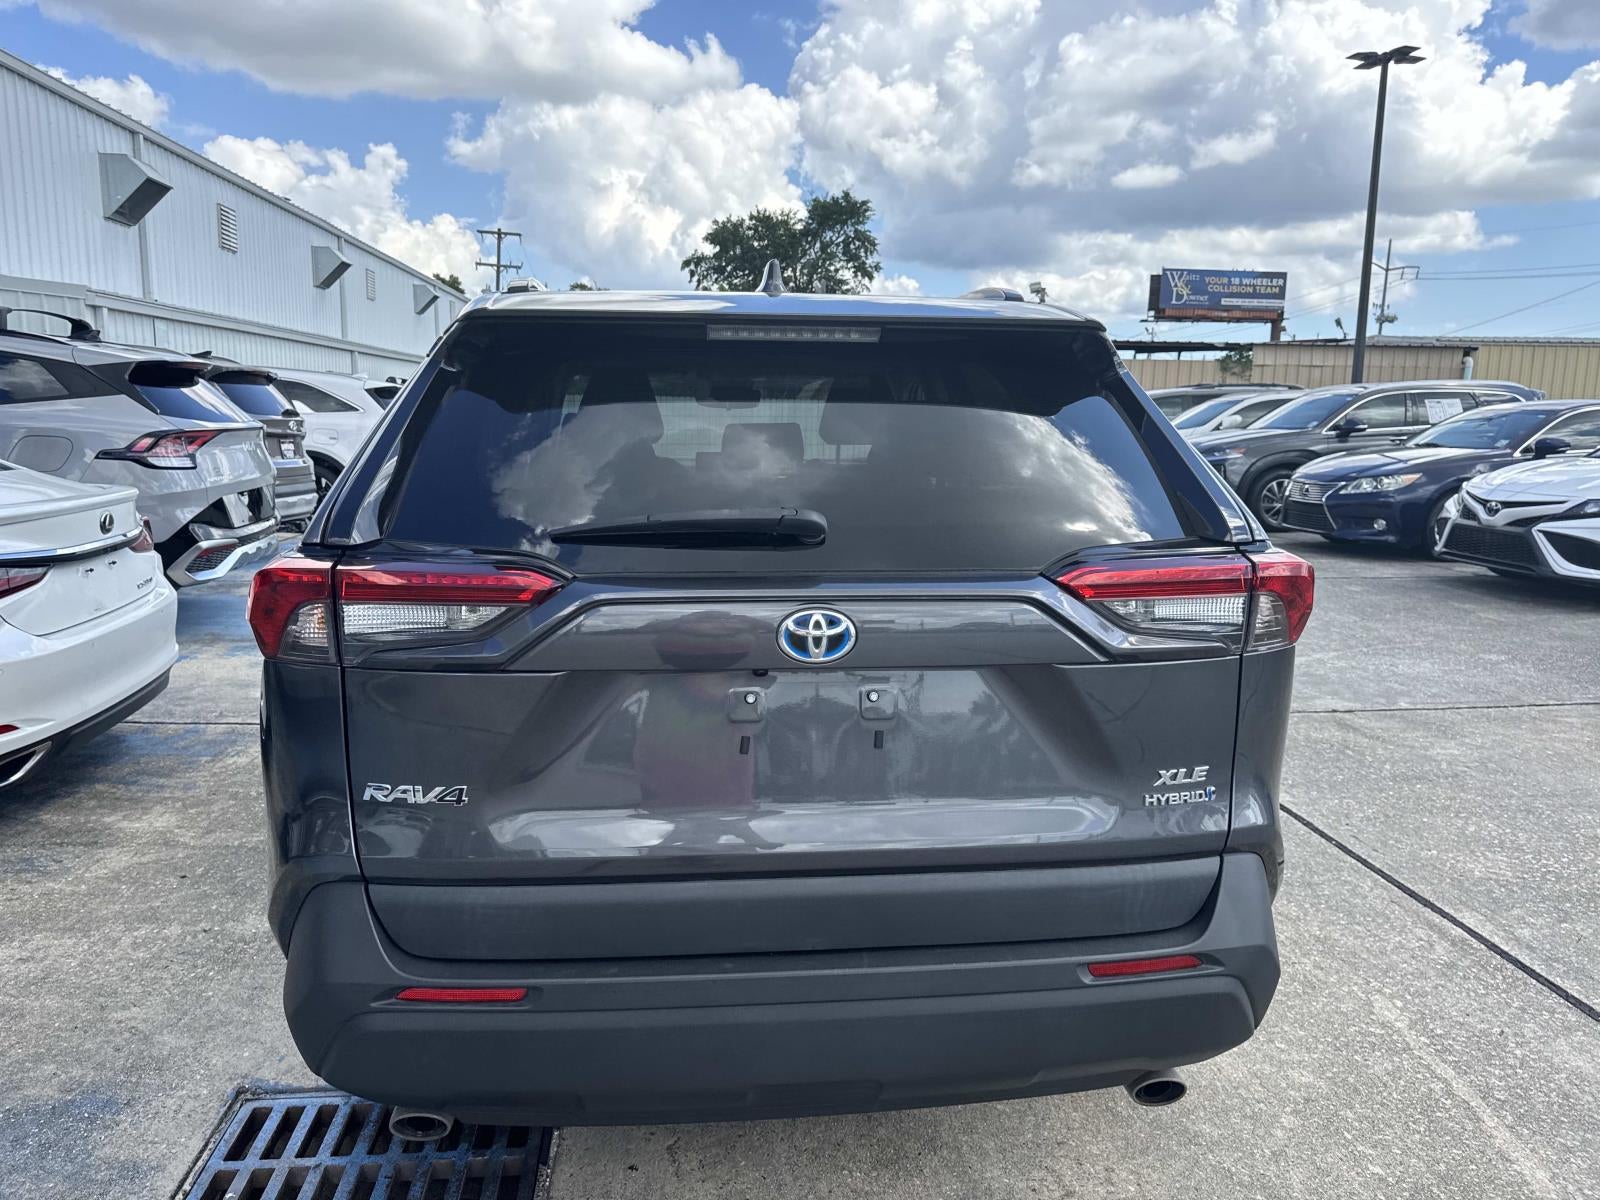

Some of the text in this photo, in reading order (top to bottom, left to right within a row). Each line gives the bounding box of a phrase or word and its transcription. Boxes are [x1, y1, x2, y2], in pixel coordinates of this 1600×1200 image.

[1204, 276, 1285, 287] YOUR 18 WHEELER
[1207, 284, 1280, 294] COLLISION TEAM
[1153, 765, 1210, 787] XLE
[362, 782, 469, 807] RAV4
[1144, 790, 1206, 807] HYBRID
